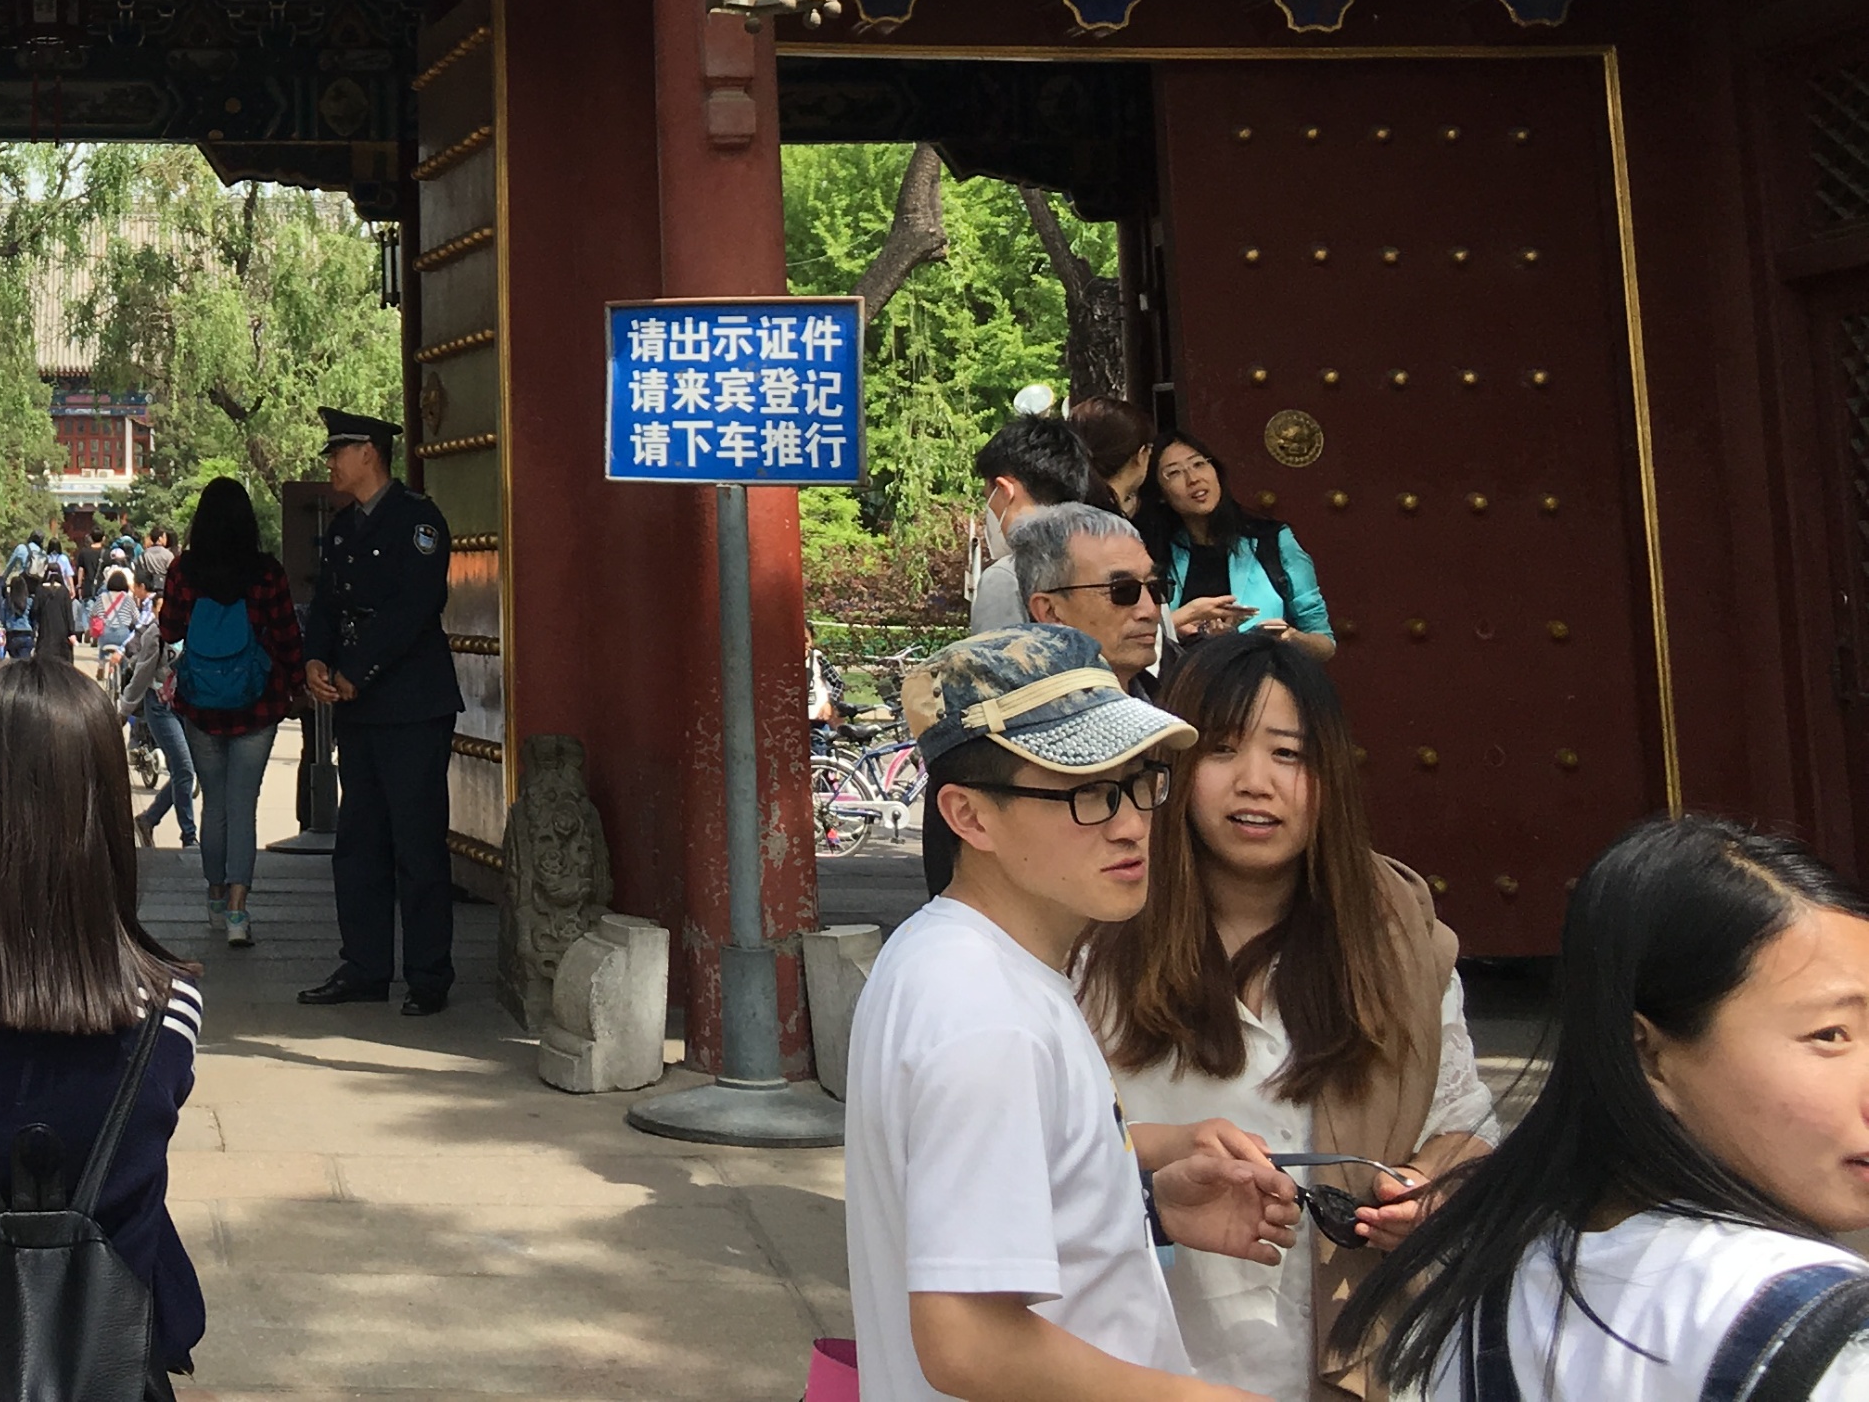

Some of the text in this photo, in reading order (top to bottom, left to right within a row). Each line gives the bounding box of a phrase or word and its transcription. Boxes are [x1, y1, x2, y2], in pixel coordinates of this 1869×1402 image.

[627, 315, 843, 362] 请出示证件
[628, 367, 844, 417] 请来宾登记
[629, 420, 848, 468] 请下车推行
